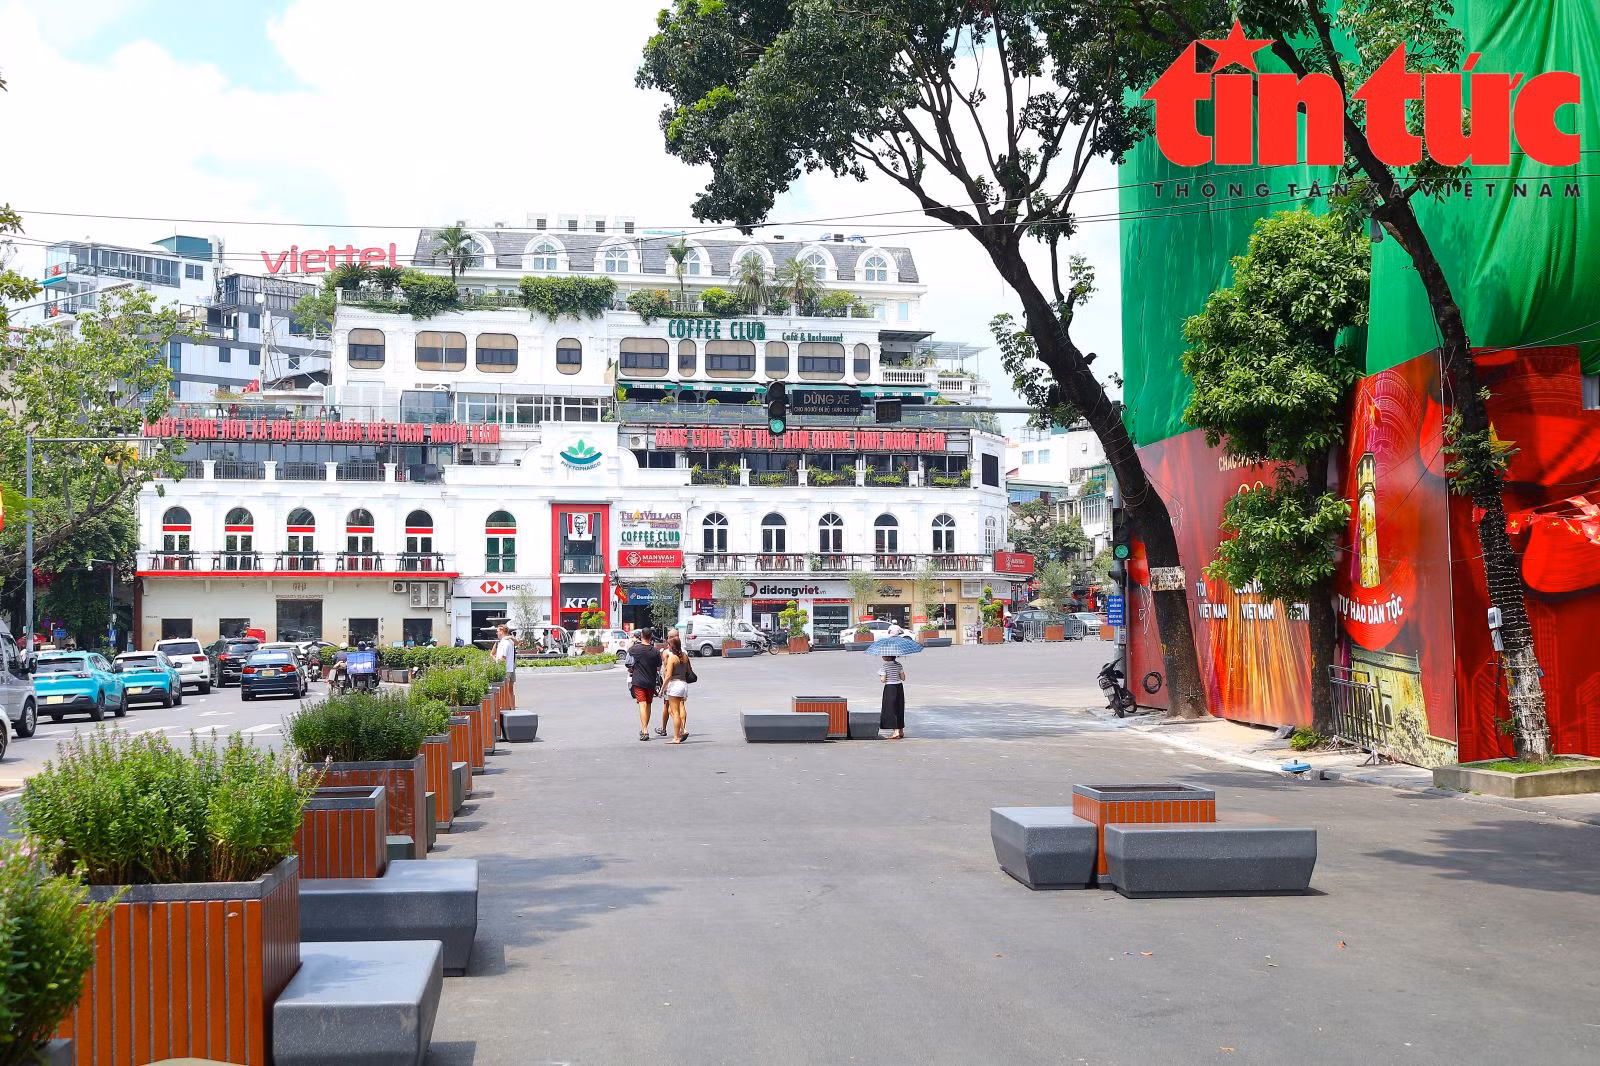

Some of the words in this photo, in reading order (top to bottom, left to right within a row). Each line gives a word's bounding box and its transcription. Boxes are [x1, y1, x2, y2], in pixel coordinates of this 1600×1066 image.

[260, 242, 402, 274] viettel
[668, 319, 721, 340] COFFEE
[730, 321, 766, 341] CLUB
[800, 332, 806, 341] &
[807, 332, 844, 343] Restaurant
[803, 391, 834, 405] DỪNG
[837, 394, 850, 405] XE
[183, 413, 218, 443] CỘNG
[295, 415, 321, 441] CHỦ
[367, 417, 393, 446] VIỆT
[395, 422, 425, 443] NAM
[782, 430, 809, 449] NAM
[811, 430, 851, 450] QUANG
[853, 431, 881, 451] VINH
[621, 530, 655, 542] COFFEE
[657, 530, 681, 542] CLUB
[564, 597, 598, 609] KFC
[1198, 598, 1212, 622] VIỆT
[1212, 603, 1228, 619] NAM
[1240, 599, 1257, 621] VIỆT
[1257, 603, 1275, 620] NAM
[1338, 593, 1350, 621] TỰ
[1350, 596, 1367, 624] HÀO
[1367, 598, 1385, 624] DÂN
[1385, 592, 1404, 625] TỘC
